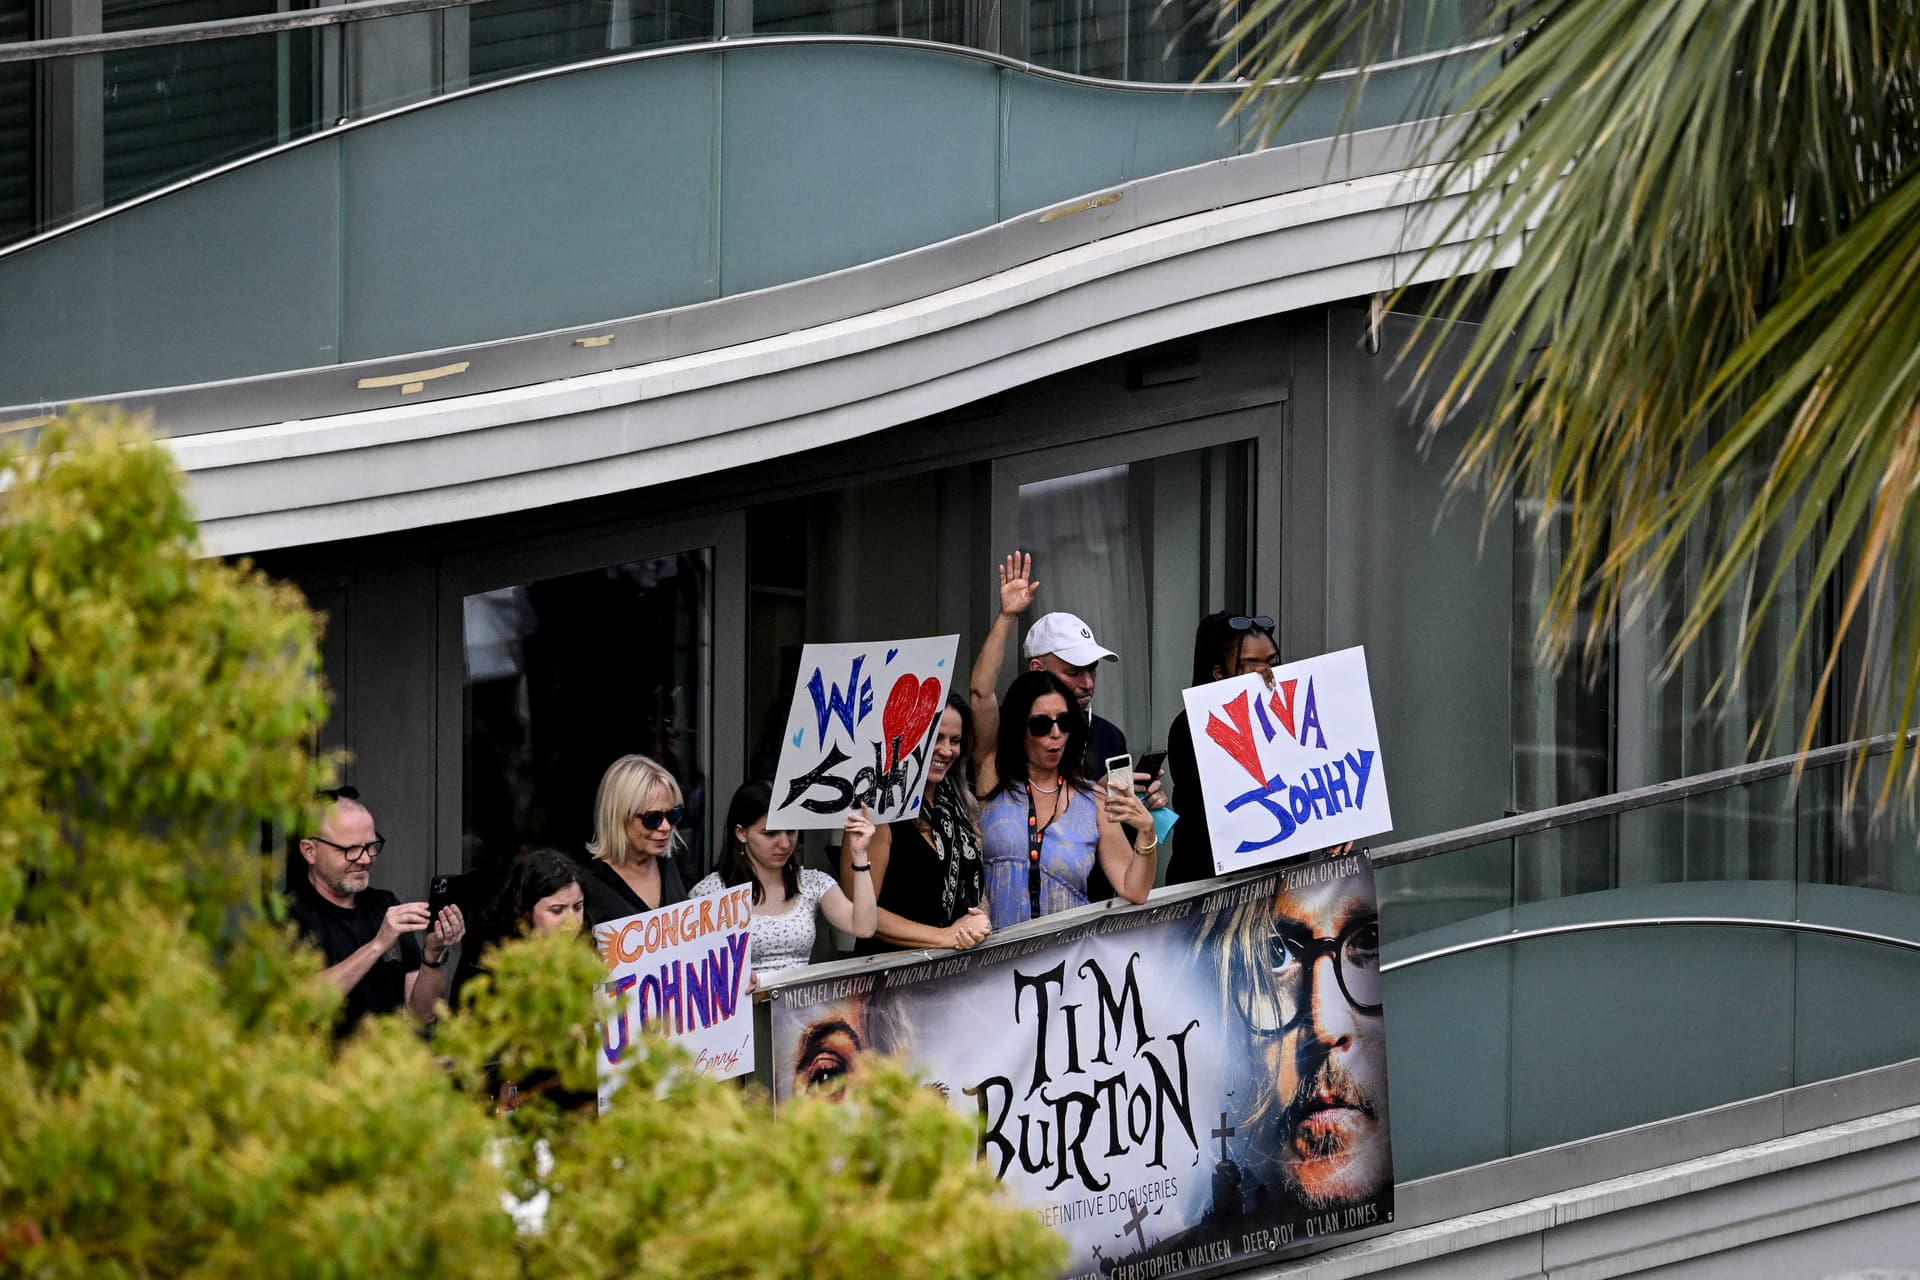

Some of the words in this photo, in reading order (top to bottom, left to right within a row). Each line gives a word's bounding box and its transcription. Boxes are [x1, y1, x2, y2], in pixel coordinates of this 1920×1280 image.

[1205, 675, 1328, 791] VIVA
[616, 888, 751, 963] CONGRATS
[784, 987, 829, 1009] MICHAEL
[832, 975, 876, 999] KEATON
[885, 966, 931, 988] WINONA
[934, 955, 971, 979] RYDER
[977, 943, 1020, 967] JOHNNY
[1101, 911, 1148, 933] BONHAM
[1151, 901, 1192, 923] CARTER
[1201, 890, 1237, 914] DANNY
[1239, 877, 1276, 905] ELFMAN
[1285, 867, 1316, 891] JENNA
[1320, 855, 1360, 882] ORTEGA
[602, 932, 750, 1065] JOHNNY
[1013, 952, 1155, 1101] TIM
[1108, 1177, 1178, 1213] DOCUSERIES
[1111, 1251, 1185, 1280] CHRISTOPHER
[1187, 1239, 1232, 1268] WALKEN
[1242, 1230, 1269, 1254] DEEP
[1273, 1223, 1294, 1246] ROY
[1306, 1211, 1339, 1238] O'LAN
[1343, 1203, 1378, 1229] JONES
